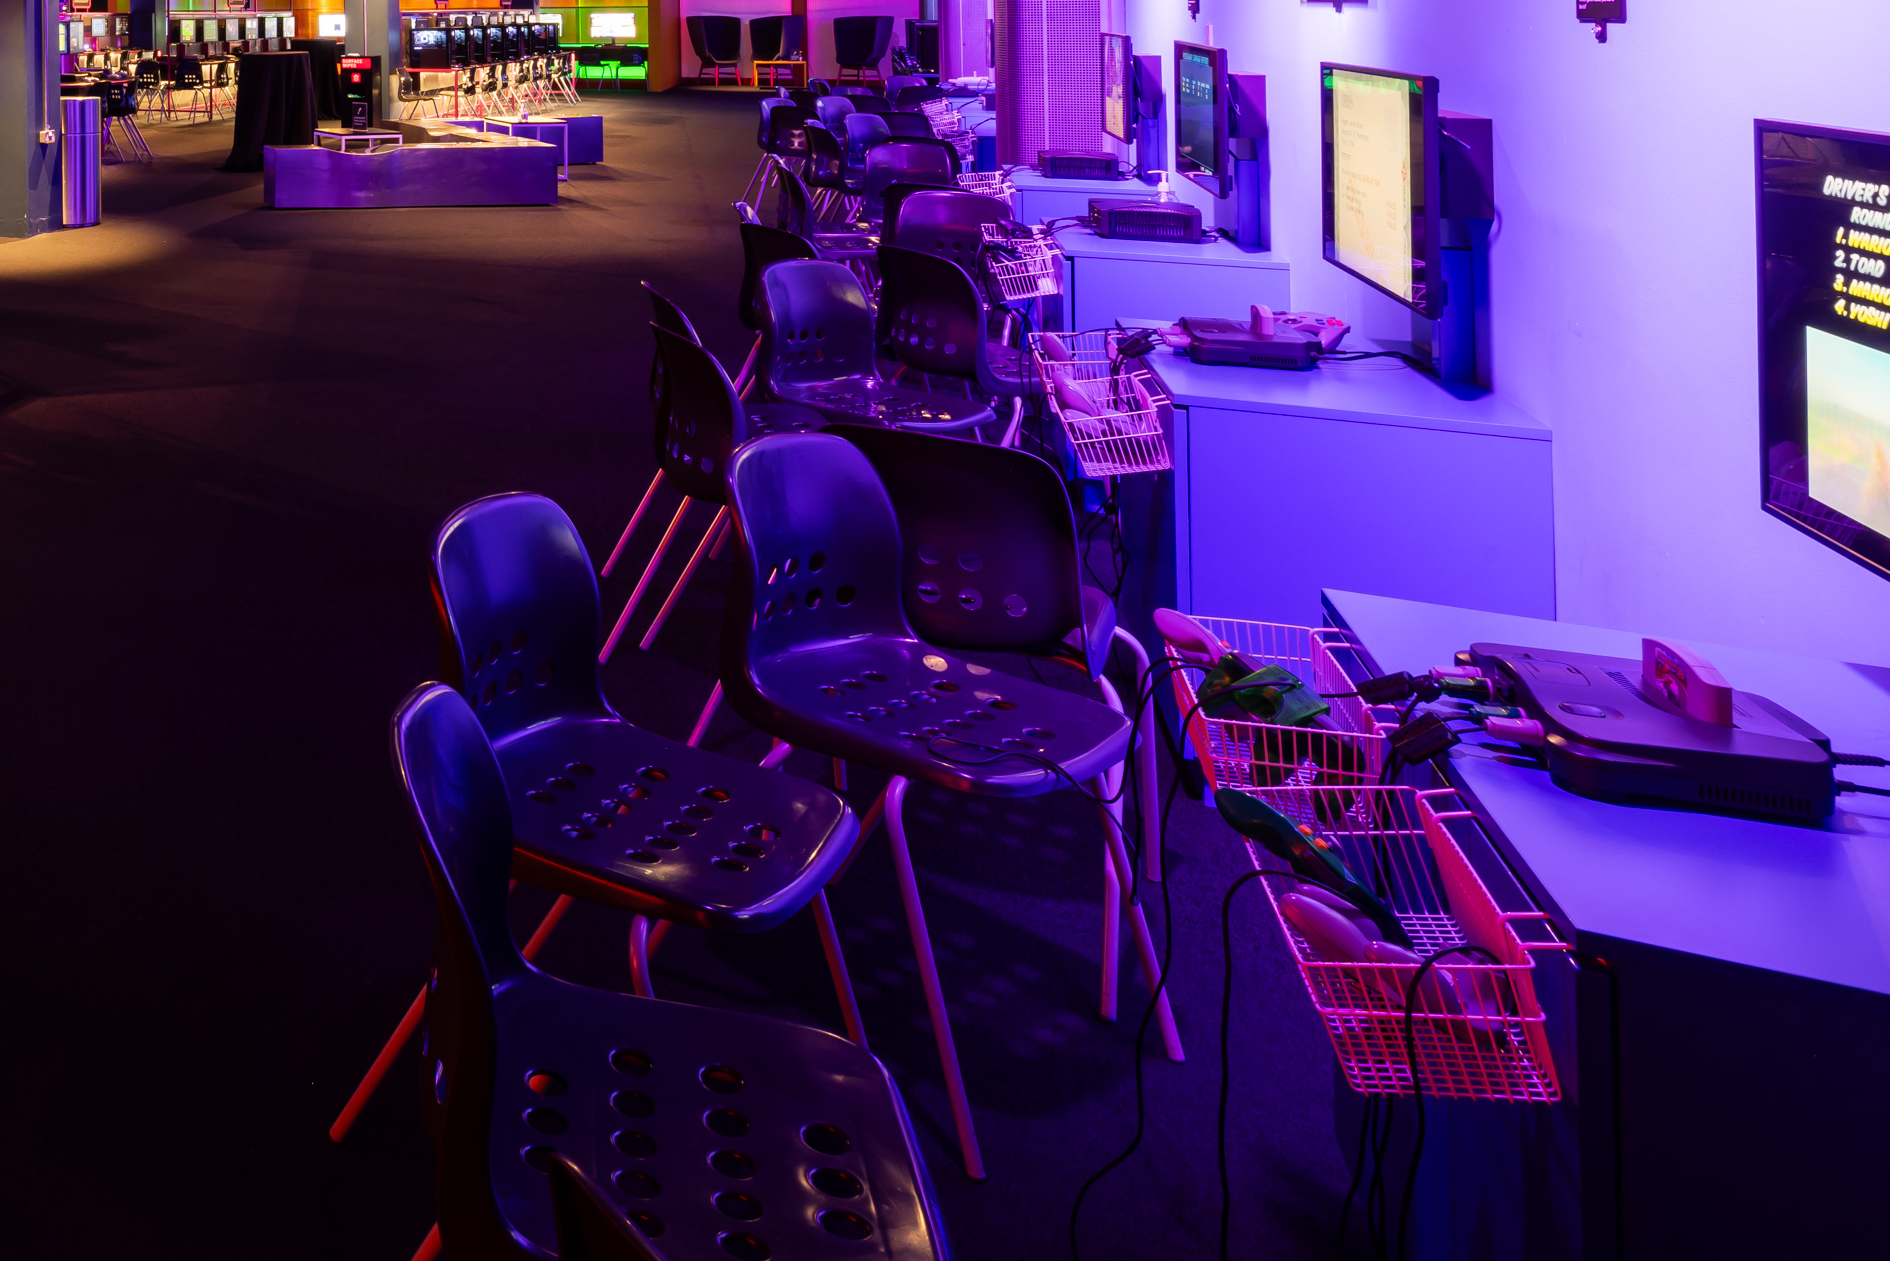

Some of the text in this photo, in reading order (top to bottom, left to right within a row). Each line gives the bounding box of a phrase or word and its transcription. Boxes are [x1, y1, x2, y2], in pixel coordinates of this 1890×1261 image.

[1823, 175, 1890, 206] DRIVER'S
[1835, 226, 1890, 256] 1. WARIO
[1834, 250, 1886, 278] 2. TOAD
[1833, 273, 1890, 306] 3. MARIO
[1834, 298, 1890, 330] 4. YOSHI
